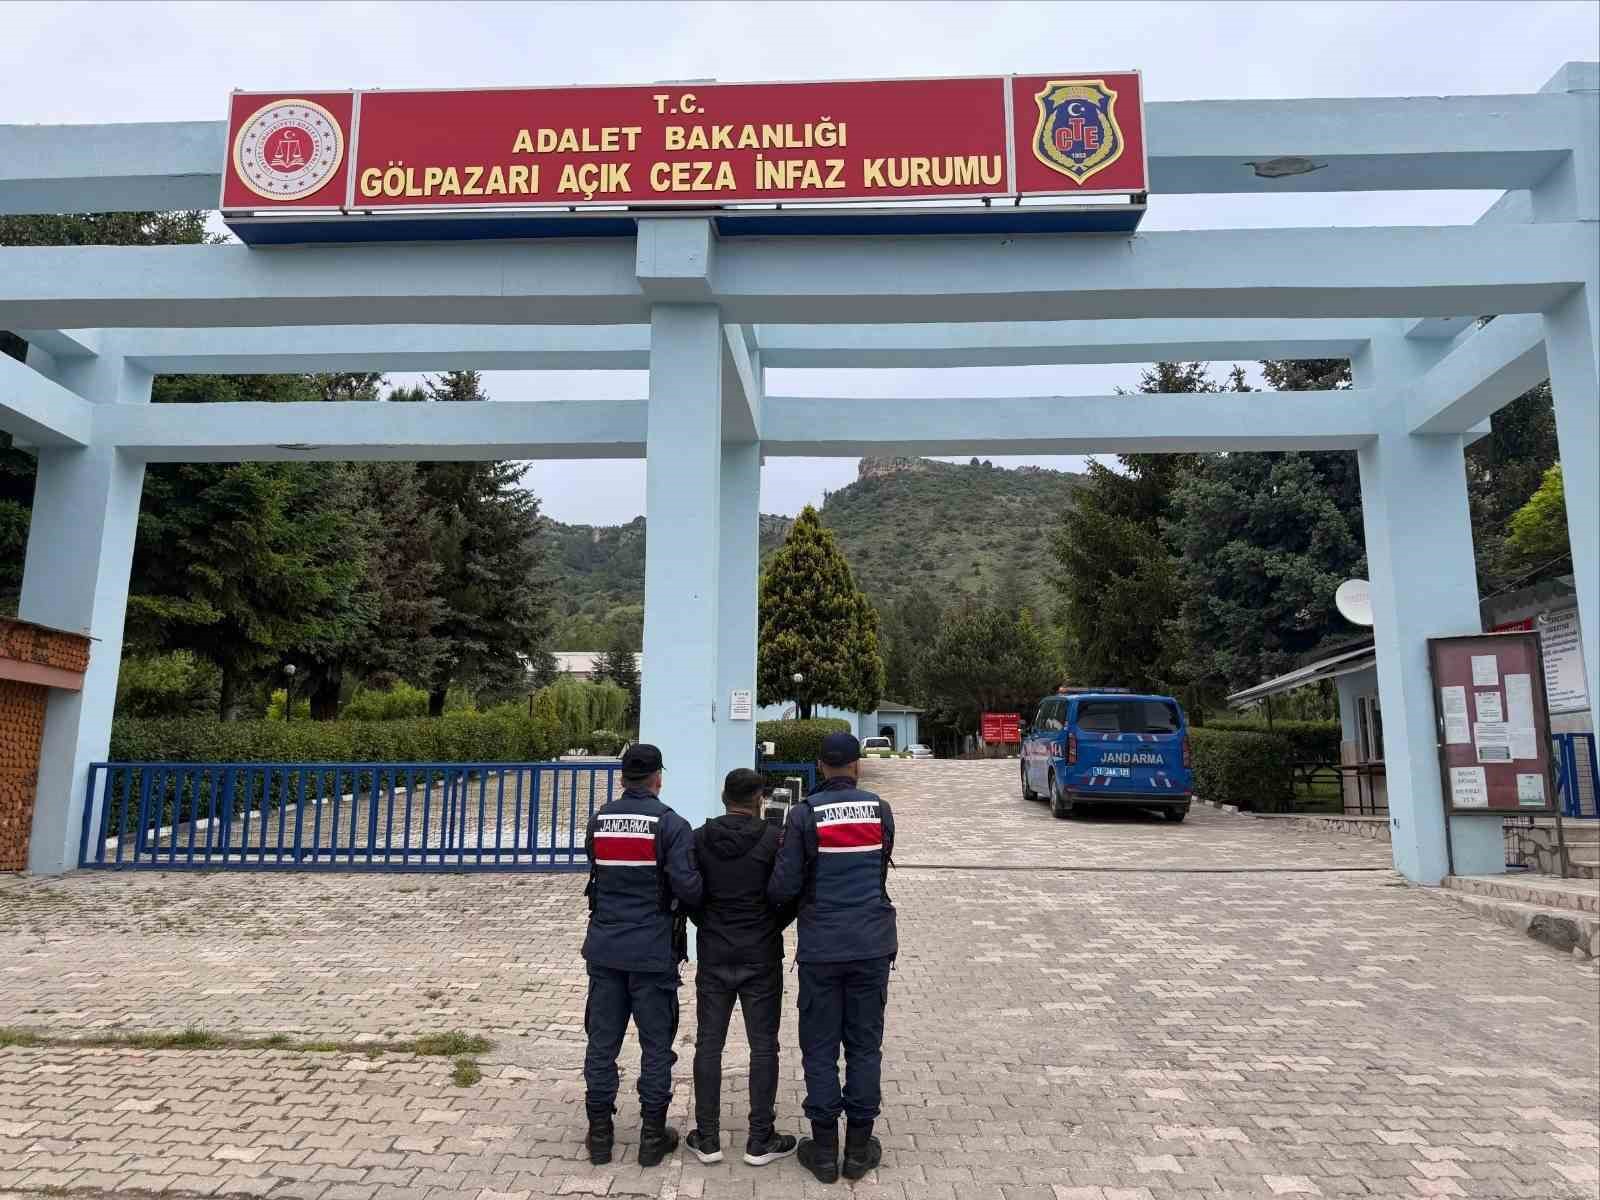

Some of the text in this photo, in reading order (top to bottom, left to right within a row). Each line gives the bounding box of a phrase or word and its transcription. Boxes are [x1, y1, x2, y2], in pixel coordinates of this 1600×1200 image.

[653, 93, 705, 114] T.C.
[512, 115, 847, 154] ADALET BAKANLIĞI
[1055, 117, 1100, 152] CTE
[360, 153, 1003, 200] GÖLPAZARI AÇIK CEZA İNFAZ KURUMU
[1100, 752, 1165, 765] JANDARMA
[822, 806, 877, 822] JANDARMA
[600, 819, 651, 834] JANDARMA
